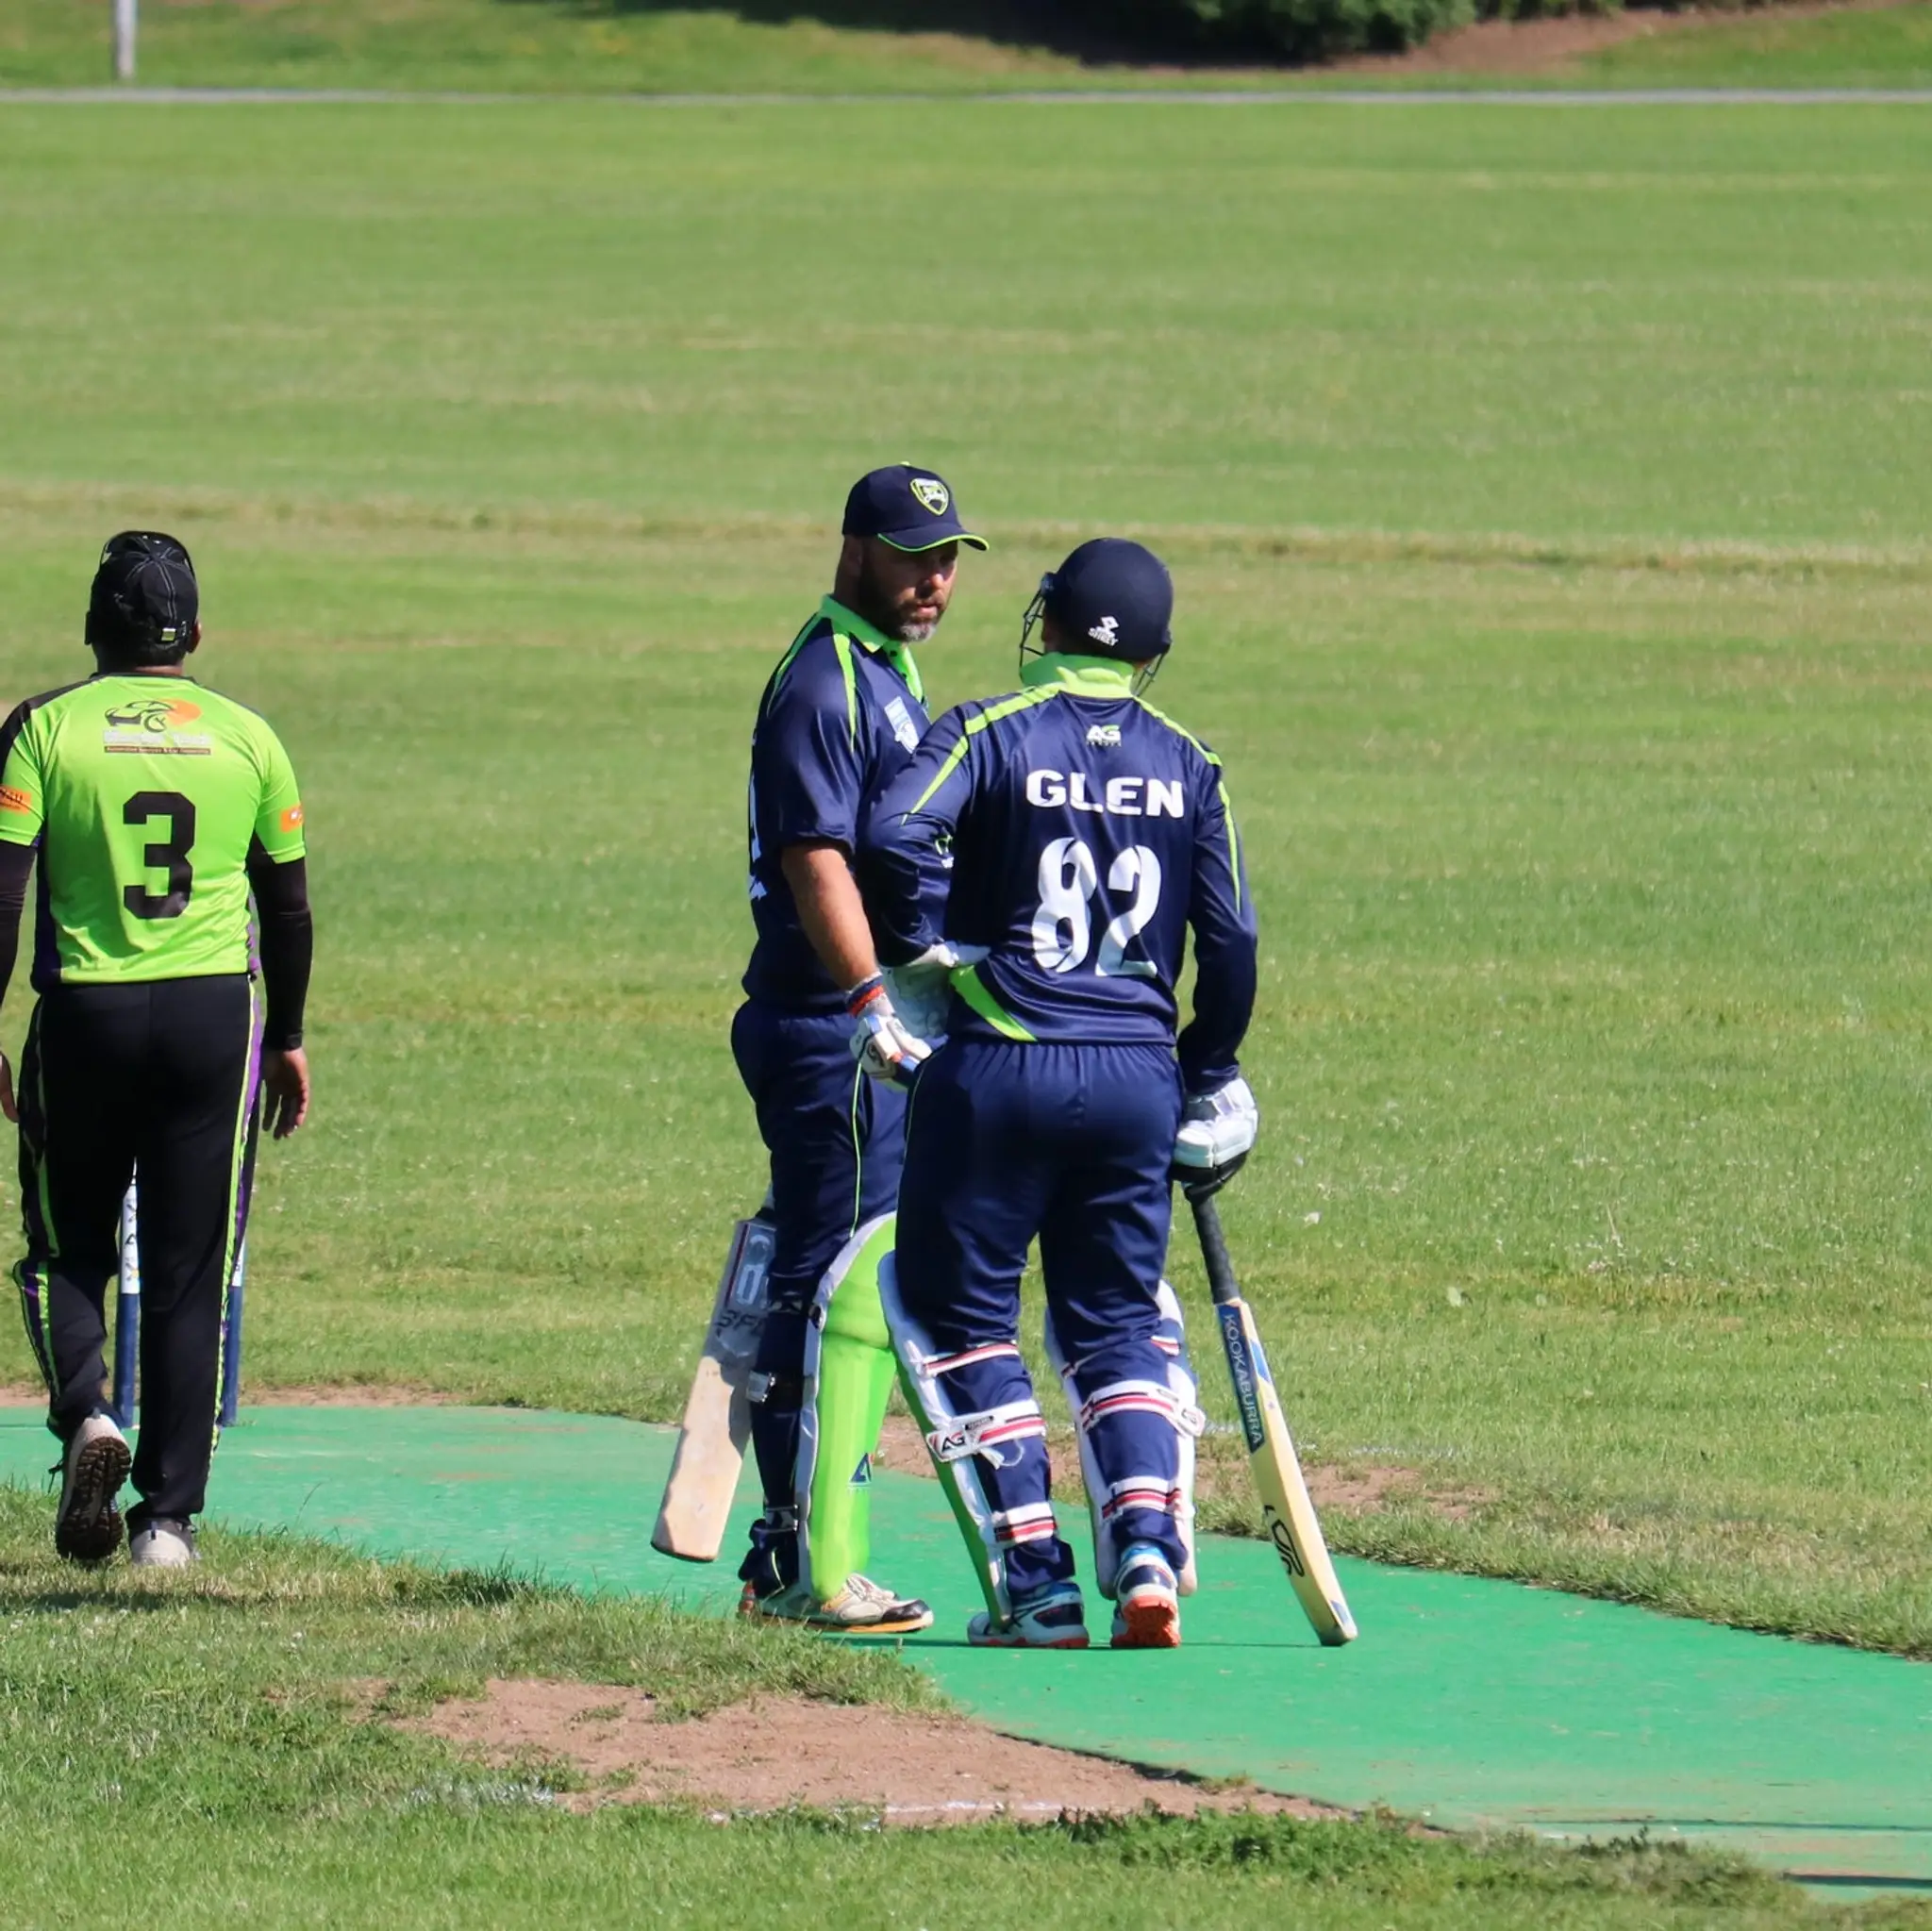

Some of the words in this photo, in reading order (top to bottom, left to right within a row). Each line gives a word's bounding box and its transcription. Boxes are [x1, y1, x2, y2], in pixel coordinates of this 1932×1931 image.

[1086, 724, 1122, 741] AG
[1026, 769, 1185, 819] GLEN
[123, 791, 196, 920] 3
[1031, 837, 1162, 978] 82
[1223, 1313, 1263, 1444] KOOKABURRA
[941, 1430, 965, 1452] AG
